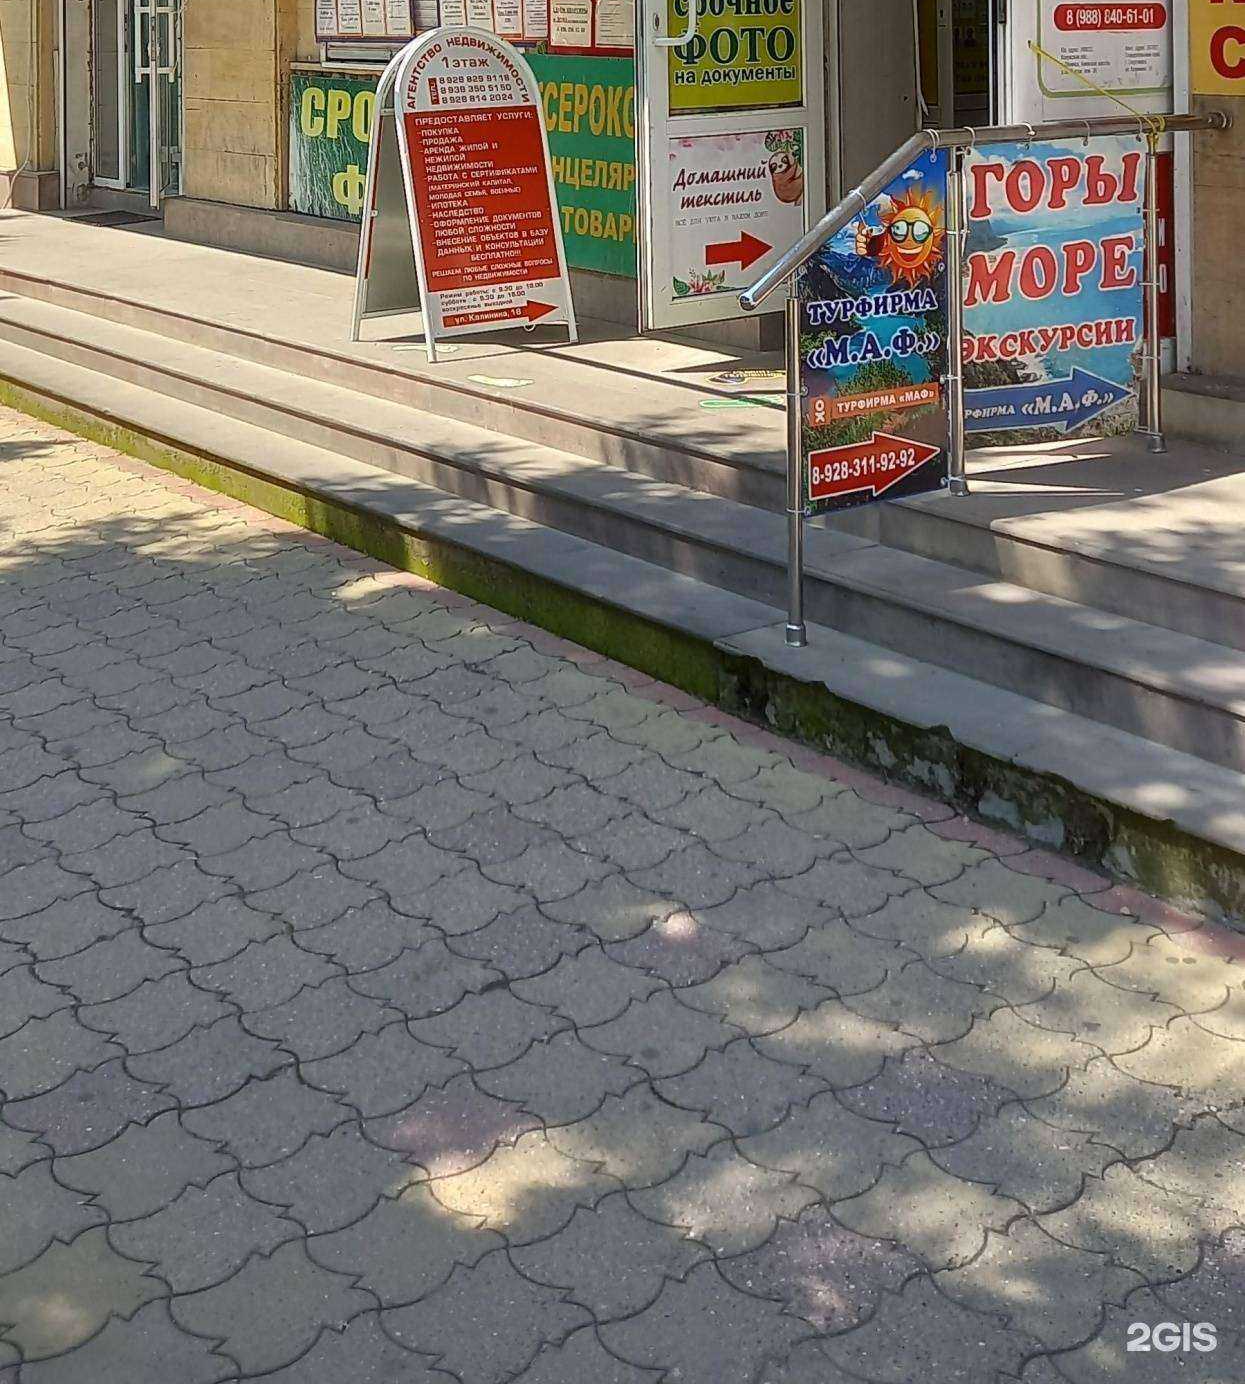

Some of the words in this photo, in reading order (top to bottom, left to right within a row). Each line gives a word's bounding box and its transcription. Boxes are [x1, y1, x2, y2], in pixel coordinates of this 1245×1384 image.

[1066, 10, 1073, 25] 8
[1076, 9, 1102, 28] (988)
[1104, 8, 1154, 24] 840-61-01
[673, 27, 795, 65] ФОТО
[407, 43, 442, 109] АГЕНТСТВО
[446, 36, 530, 103] НЕДВИЖИМОСТИ
[441, 56, 450, 69] 1
[452, 58, 490, 68] этаж
[439, 76, 445, 84] 8
[447, 76, 464, 84] 928
[675, 70, 696, 85] на
[701, 65, 796, 86] документы
[440, 86, 447, 94] 8
[442, 96, 448, 104] 8
[470, 94, 487, 102] 814
[489, 93, 514, 102] 2024
[415, 113, 492, 126] ПРЕДОСТАВЛЯЕТ
[496, 111, 533, 121] УСЛУГИ:
[539, 81, 635, 139] СЕРОКС
[459, 142, 489, 152] ЖИЛОЙ
[424, 153, 466, 164] НЕЖИЛОЙ
[425, 161, 494, 174] НЕДВИЖИМОСТИ
[470, 166, 538, 178] СЕРТИФИКАТАМИ
[673, 160, 769, 191] Домашний
[970, 152, 1141, 218] ГОРЫ
[428, 191, 462, 201] МОЛОДАЯ
[680, 188, 762, 209] текстиль
[492, 211, 542, 224] ДОКУМЕНТОВ
[561, 204, 635, 245] ТОВАР
[434, 227, 464, 238] ЛЮБОЙ
[467, 222, 516, 233] СЛОЖНОСТИ
[480, 231, 518, 242] ОБЪЕКТОВ
[530, 229, 549, 237] БАЗУ
[437, 246, 473, 258] ДАННЫХ
[485, 237, 544, 251] КОНСУЛЬТАЦИИ
[470, 249, 521, 262] БЕСПЛАТНО!!!
[432, 267, 462, 278] РЕШАЕМ
[464, 264, 488, 274] ЛЮБЫЕ
[490, 261, 522, 270] СЛОЖНЫЕ
[524, 257, 553, 267] ВОПРОСЫ
[463, 274, 473, 282] ПО
[474, 269, 528, 281] НЕДВИЖИМОСТИ
[963, 234, 1137, 308] МОРЕ
[454, 316, 467, 324] ул.
[469, 311, 509, 322] Калинина,
[510, 308, 522, 317] 18
[808, 290, 938, 325] ТУРФИРМА
[806, 327, 940, 368] «М.А.Ф.»
[962, 318, 1136, 363] ЭКСКУРСИИ
[837, 395, 896, 413] ТУРФИРМА
[899, 389, 935, 402] «МАФ»
[1021, 389, 1114, 416] «М.А.Ф.»
[812, 447, 917, 486] 8-928-311-92-92
